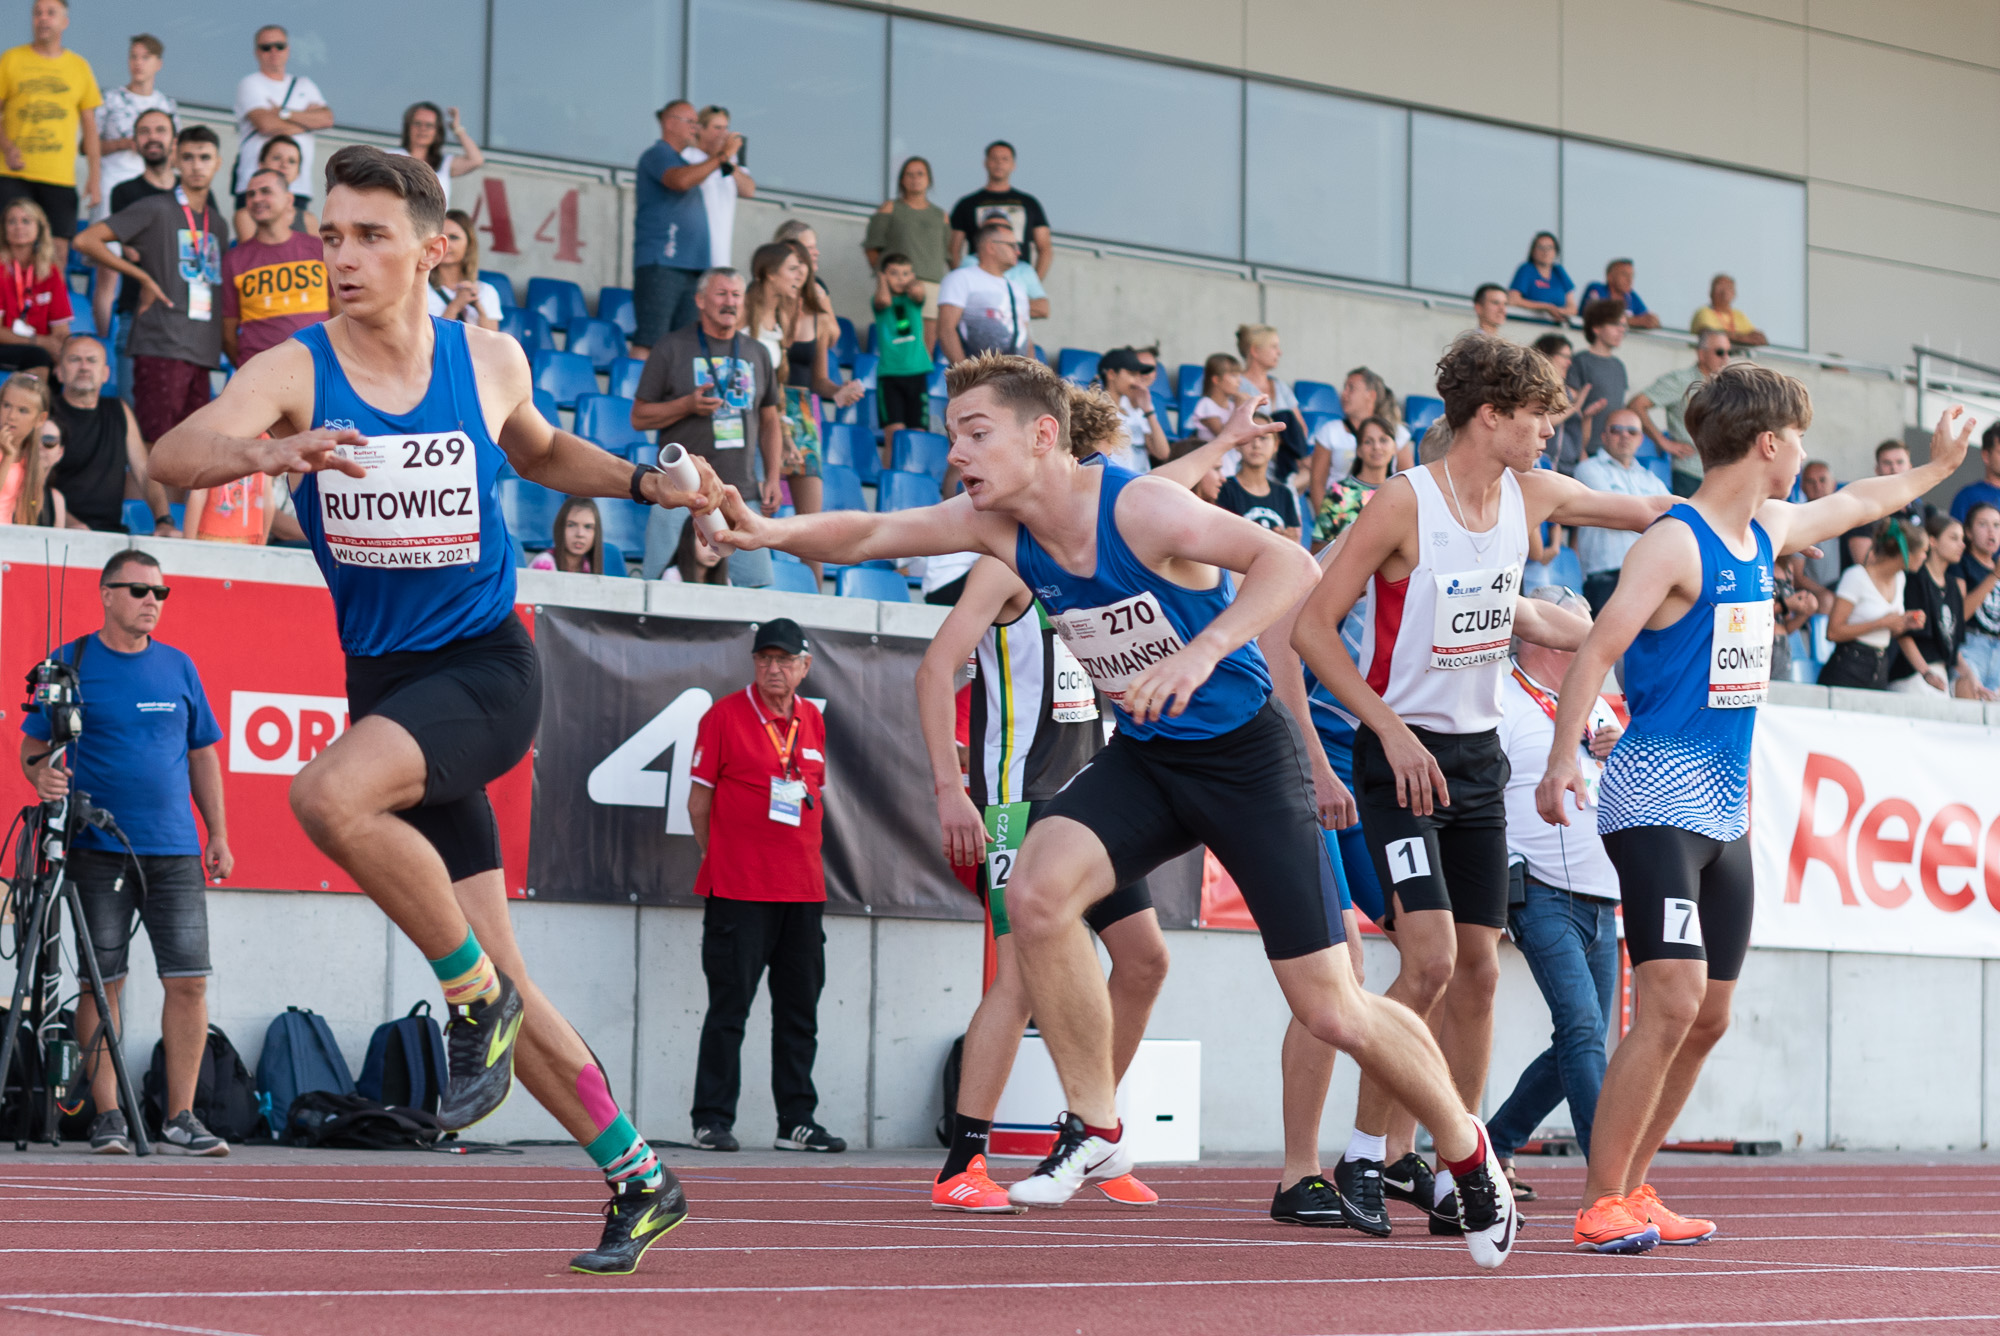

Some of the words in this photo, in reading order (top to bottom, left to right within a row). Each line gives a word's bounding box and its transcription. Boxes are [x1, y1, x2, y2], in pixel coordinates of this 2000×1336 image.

[242, 263, 323, 298] CROSS
[402, 437, 465, 469] 269
[324, 486, 473, 521] RUTOWICZ
[335, 547, 432, 565] WŁOCŁAWEK
[437, 547, 470, 563] 2021
[427, 536, 458, 545] POLSKI
[1453, 586, 1482, 595] OLIMP
[1101, 600, 1155, 635] 270
[1452, 606, 1511, 634] CZUBA
[1437, 651, 1497, 667] WŁOCŁAWEK
[244, 705, 351, 762] OR
[994, 853, 1011, 886] 2
[1398, 841, 1417, 874] 1
[1675, 902, 1693, 939] 7
